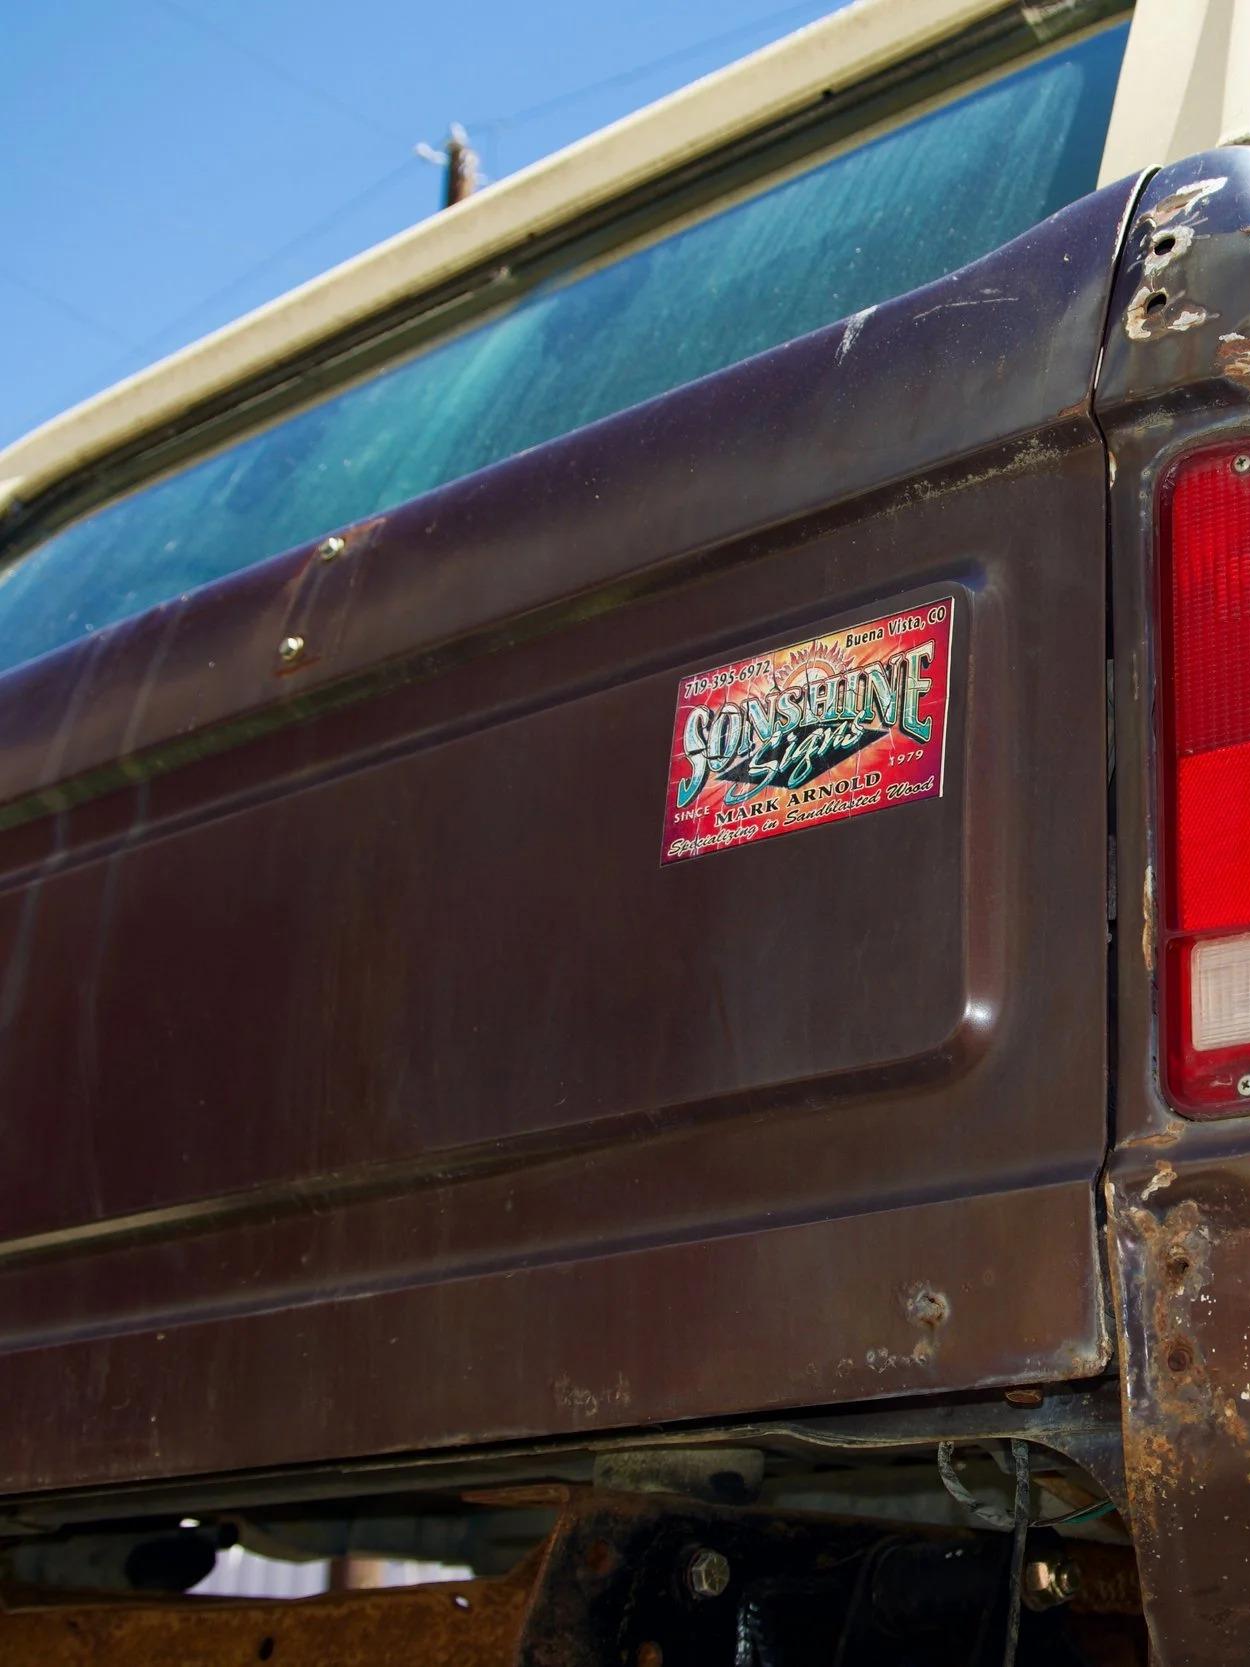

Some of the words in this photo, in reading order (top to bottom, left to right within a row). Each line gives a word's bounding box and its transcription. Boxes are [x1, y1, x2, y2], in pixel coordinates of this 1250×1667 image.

[845, 628, 884, 648] Buena
[887, 617, 925, 635] Vista,
[928, 606, 946, 624] CO
[684, 660, 771, 698] 719-395-6972
[677, 640, 935, 807] SONSHINE
[724, 714, 867, 806] Signs
[667, 824, 758, 856] Specializing
[761, 818, 779, 832] in
[782, 788, 882, 825] Sandblasted
[885, 774, 935, 800] Wood
[674, 806, 710, 823] SINCE
[889, 750, 924, 766] 1979
[715, 797, 780, 827] MARK
[786, 772, 882, 808] ARNOLD
